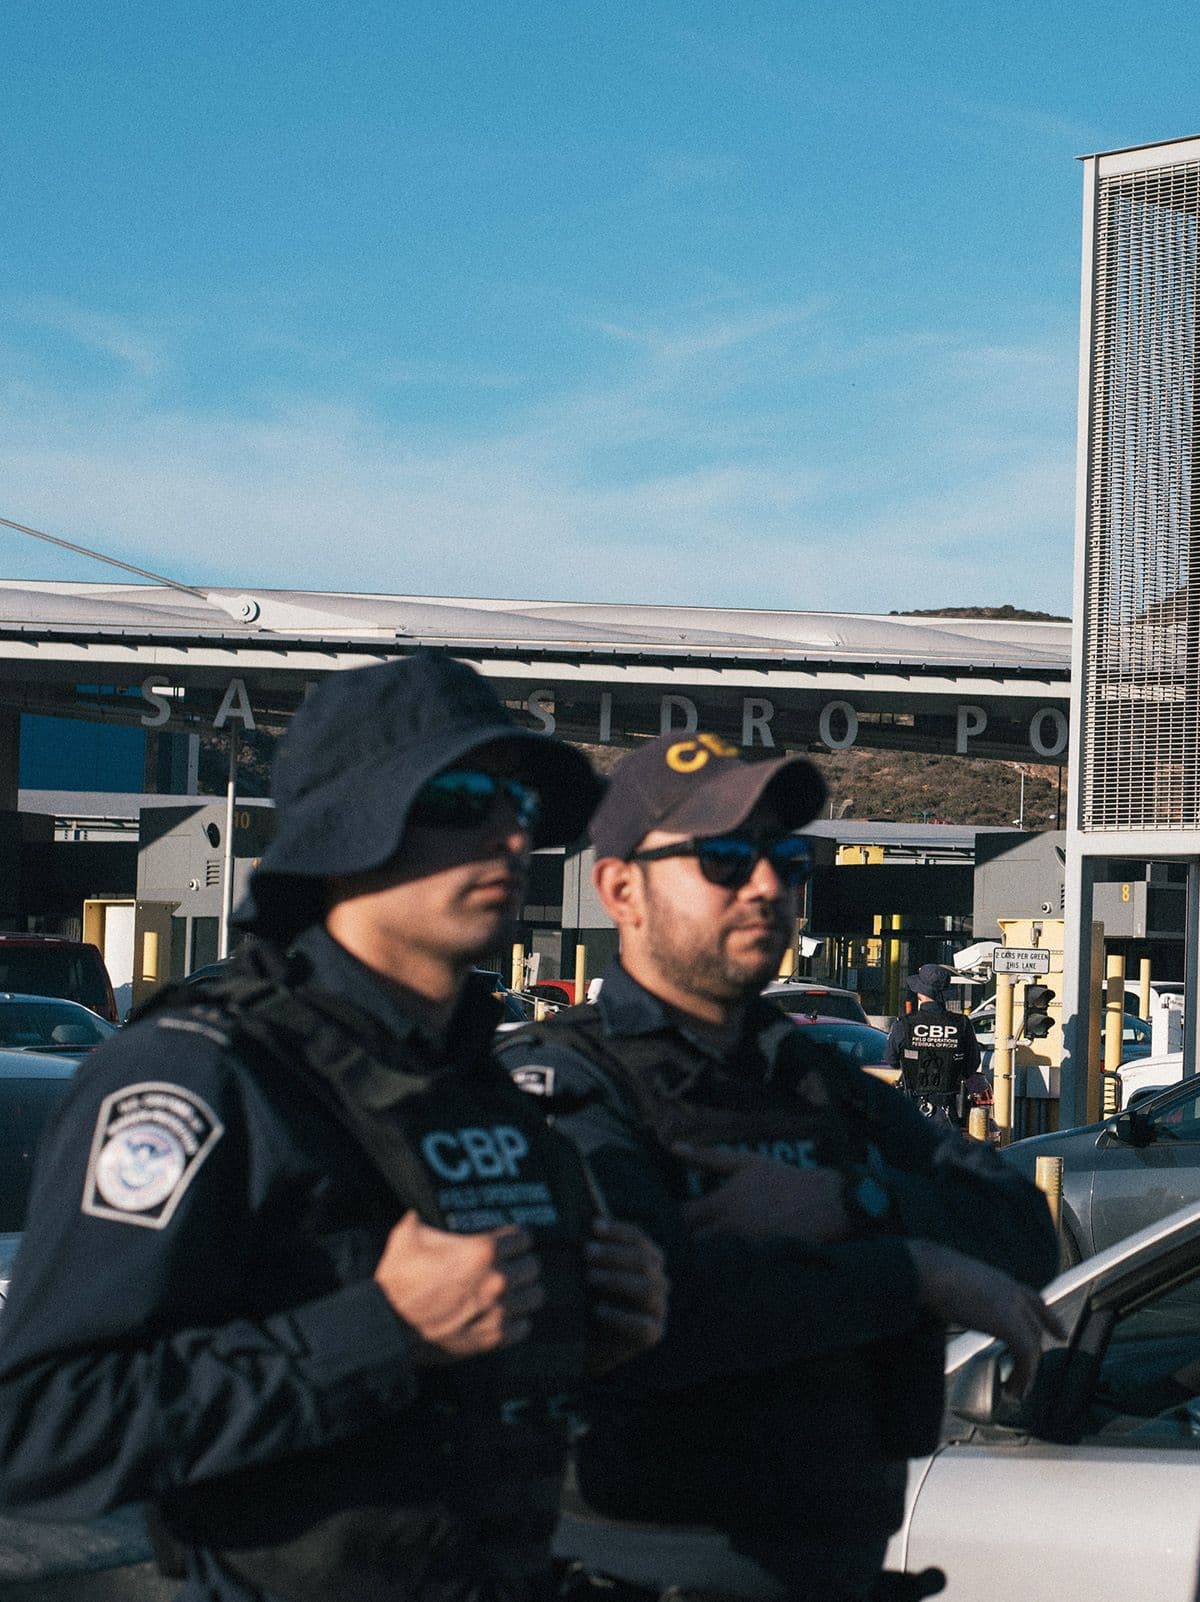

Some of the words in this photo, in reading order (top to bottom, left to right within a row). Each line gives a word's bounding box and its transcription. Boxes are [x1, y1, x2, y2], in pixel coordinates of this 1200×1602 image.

[138, 676, 318, 730] SA
[527, 690, 859, 750] SIDRO
[956, 705, 1068, 757] PO
[1122, 884, 1130, 902] 8
[1001, 951, 1016, 960] CARS
[1017, 952, 1028, 960] PER
[1029, 953, 1049, 961] GREEN
[1006, 961, 1020, 970] THIS
[1021, 962, 1037, 970] LANE
[913, 1024, 958, 1038] CBP
[422, 1124, 529, 1181] CBP
